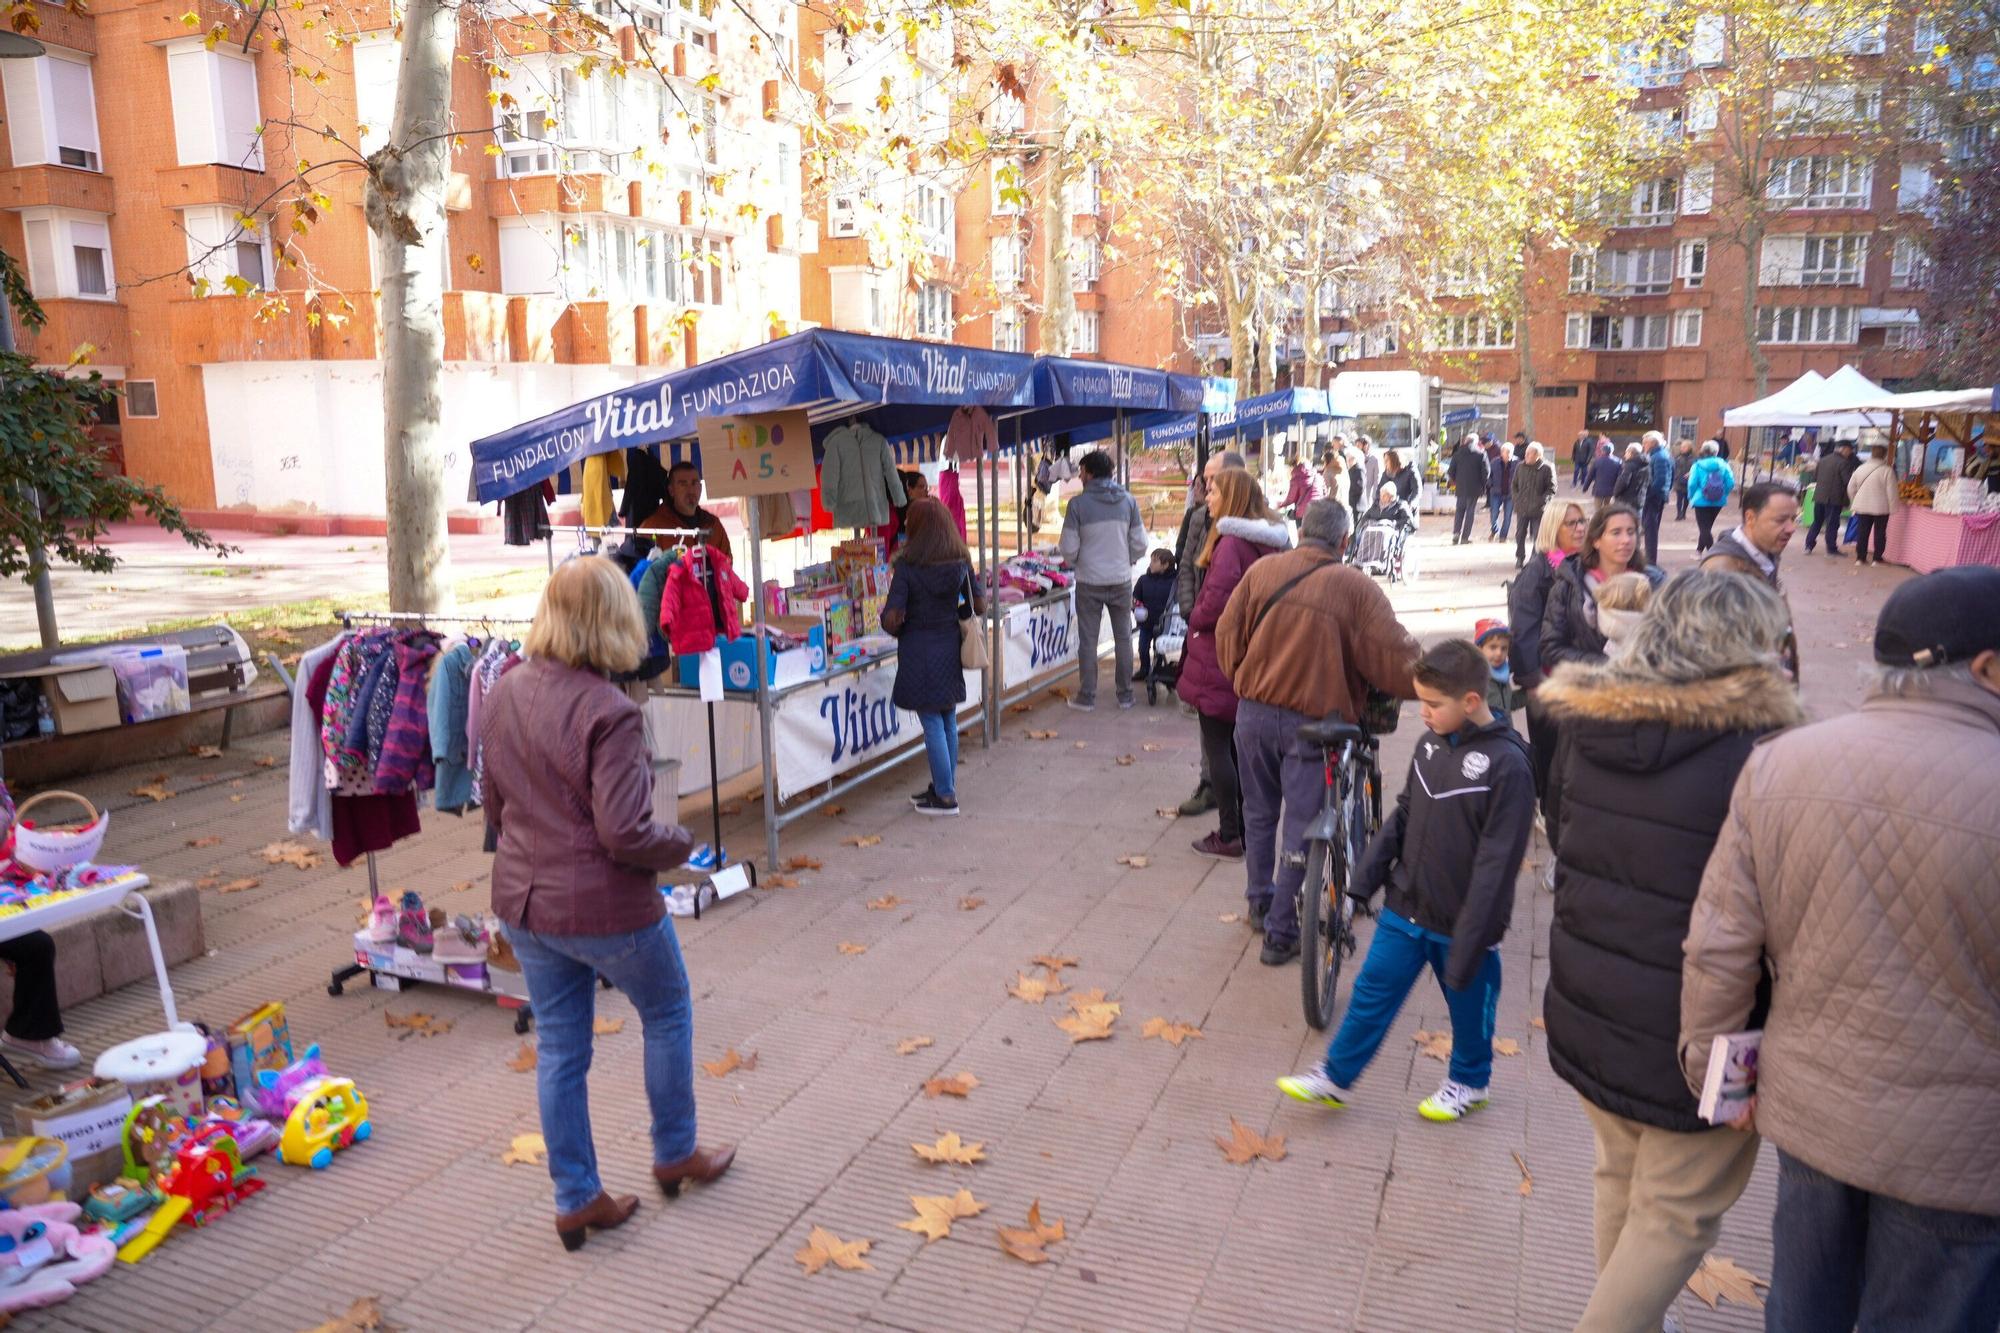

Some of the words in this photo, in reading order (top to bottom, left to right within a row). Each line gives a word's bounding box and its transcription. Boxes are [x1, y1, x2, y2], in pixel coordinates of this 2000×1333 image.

[852, 360, 921, 387] FUNDACIÓN
[922, 346, 967, 395] Vital
[967, 370, 1016, 391] FUNDAZIOA
[1108, 365, 1132, 399] Vital
[492, 425, 585, 484] FUNDACIÓN
[585, 383, 674, 443] Vital
[681, 363, 797, 417] FUNDAZIOA
[1211, 407, 1237, 429] ital
[1239, 399, 1289, 419] FUNDAZIOA
[721, 423, 784, 452] TODO
[732, 458, 747, 480] A
[1028, 608, 1073, 669] Vital
